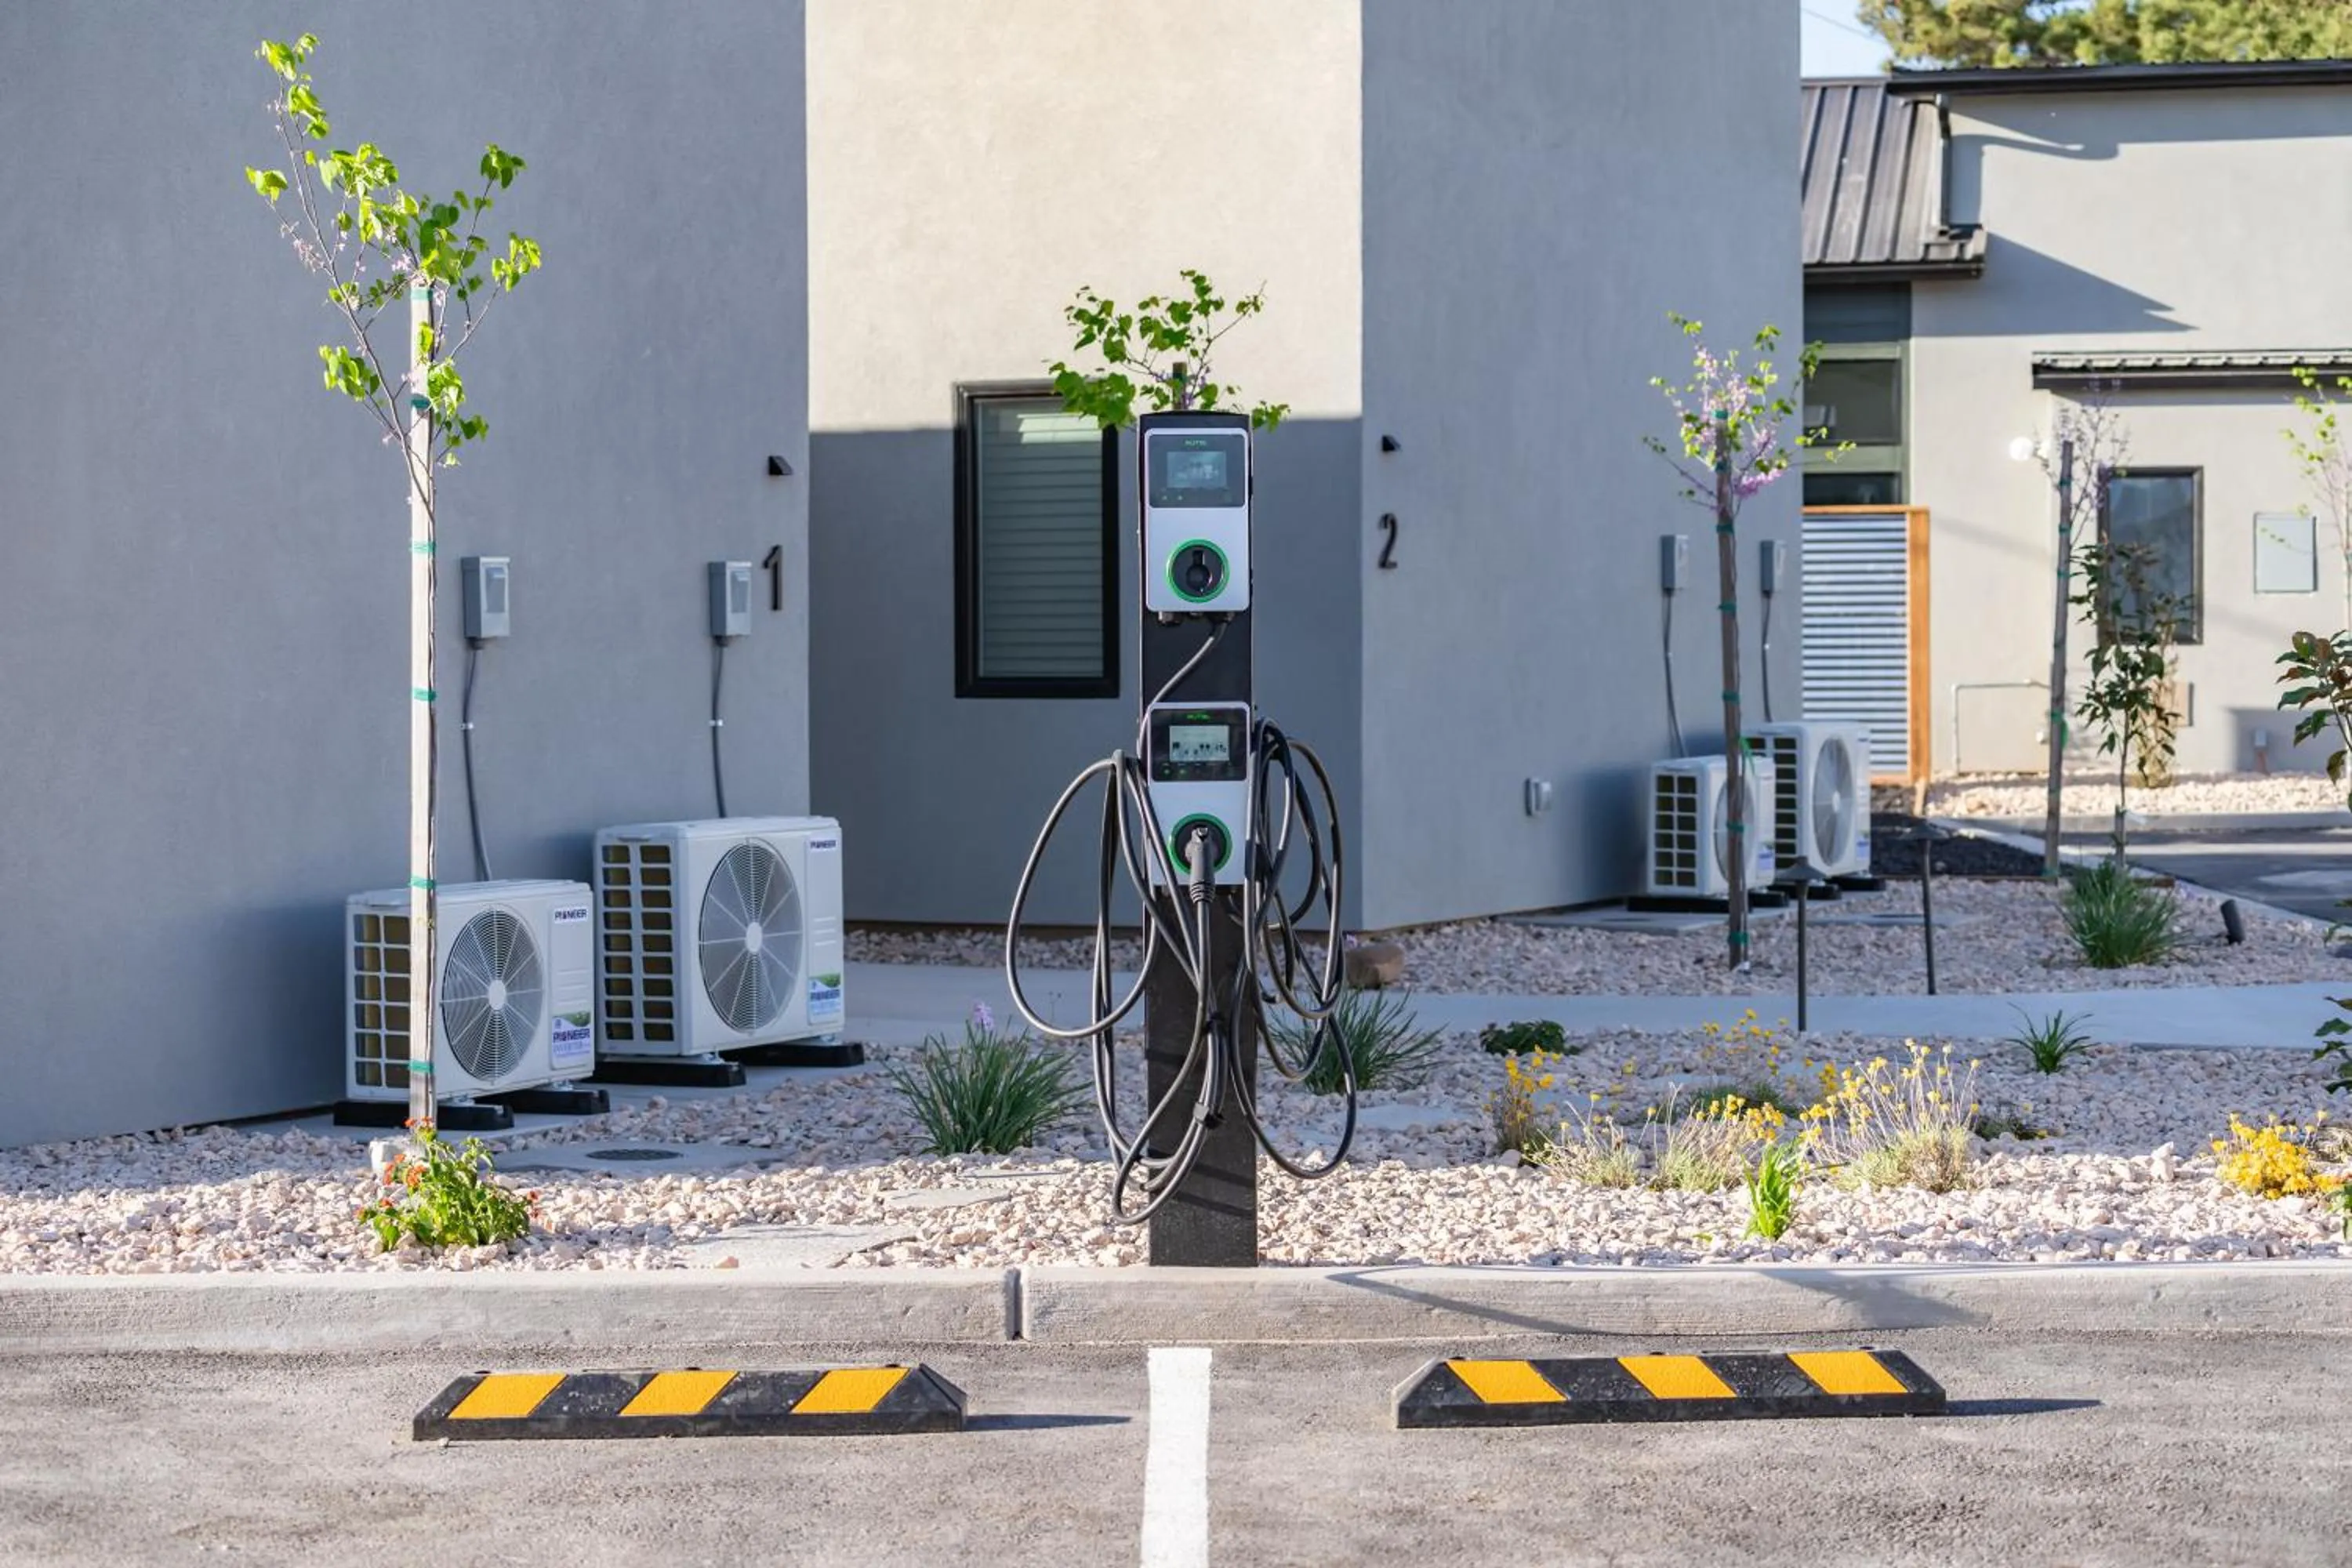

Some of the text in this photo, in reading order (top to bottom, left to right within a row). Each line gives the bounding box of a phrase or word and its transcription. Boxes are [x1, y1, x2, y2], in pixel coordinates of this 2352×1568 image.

[1377, 513, 1398, 569] 2
[762, 544, 782, 611] 1
[554, 909, 587, 920] PIONEER
[553, 1028, 590, 1044] PIONEER
